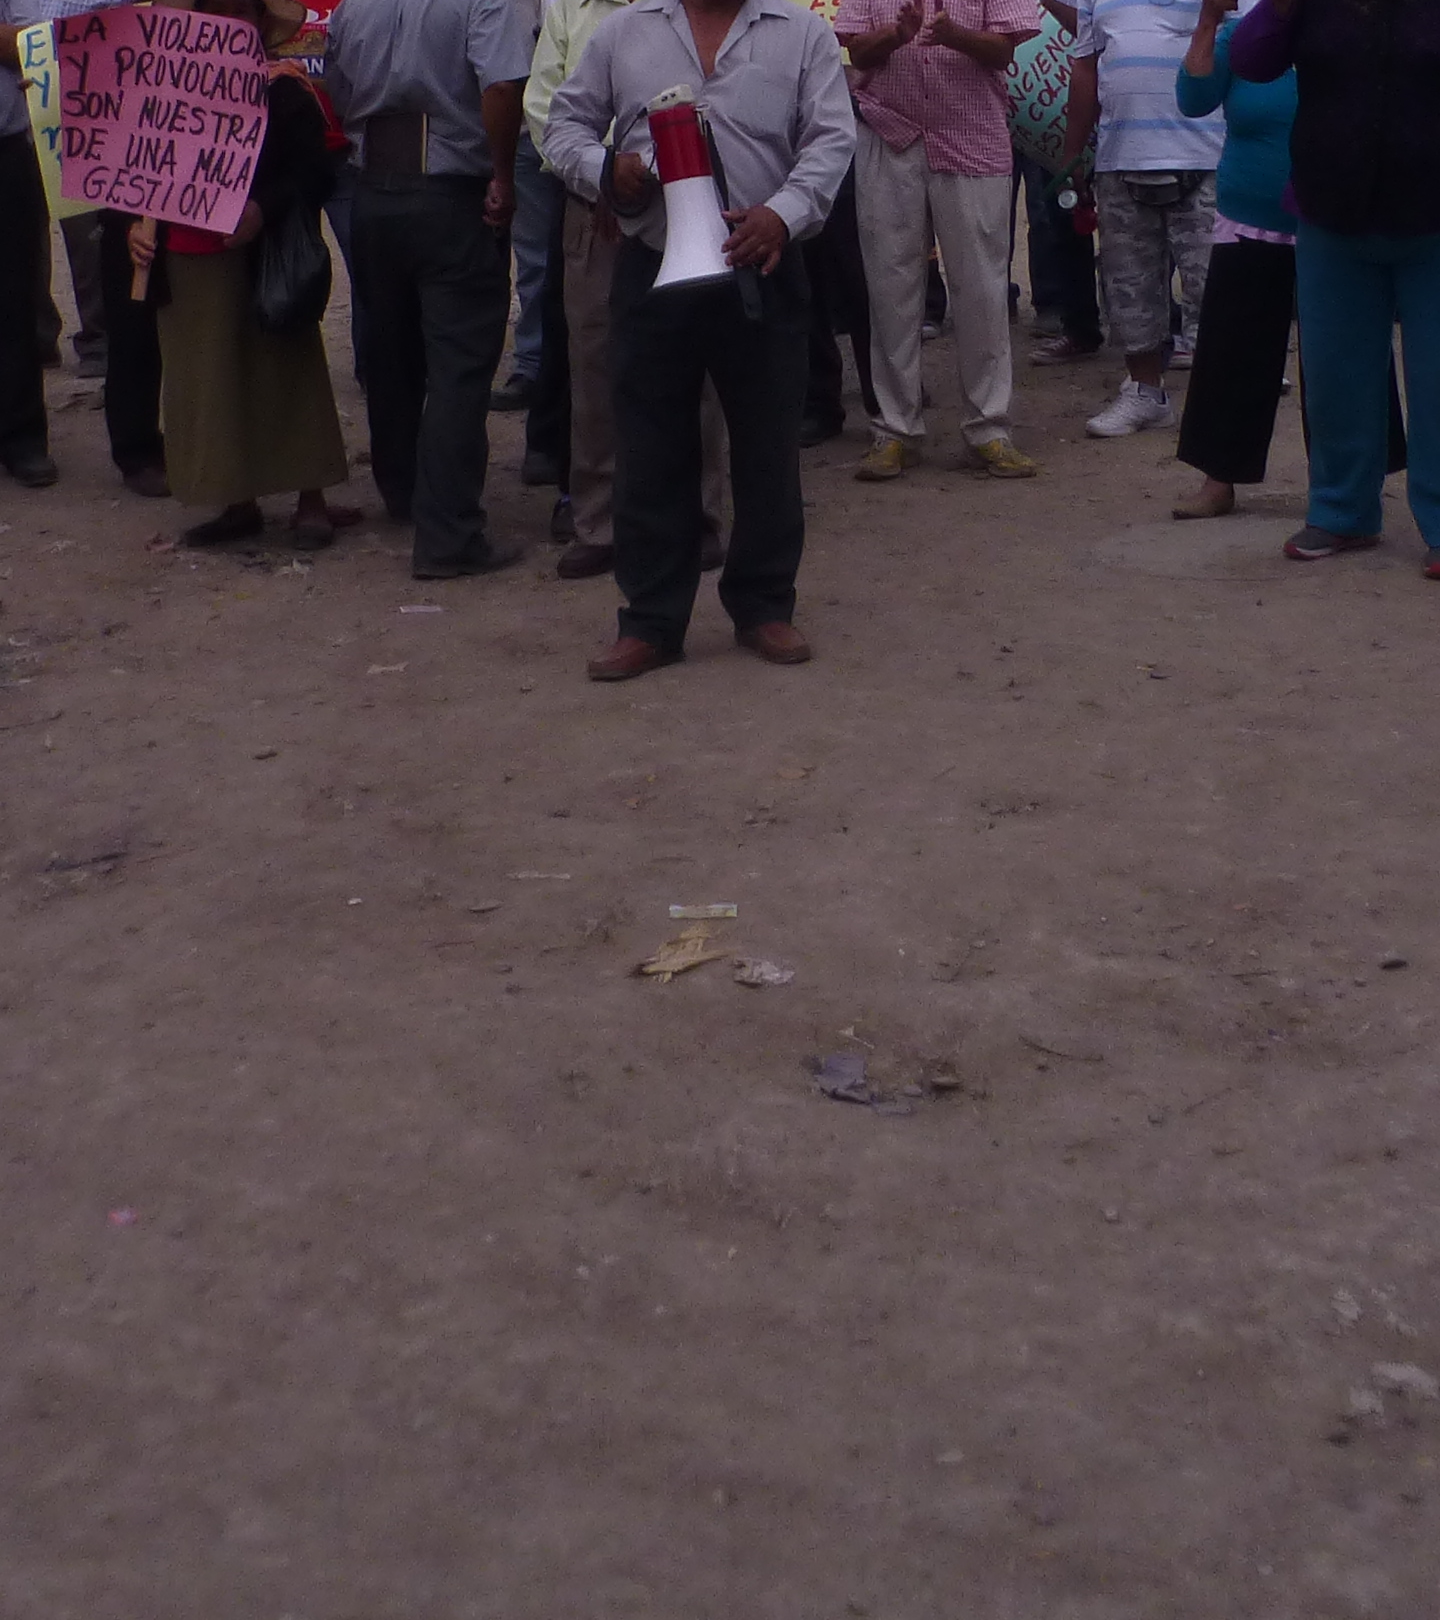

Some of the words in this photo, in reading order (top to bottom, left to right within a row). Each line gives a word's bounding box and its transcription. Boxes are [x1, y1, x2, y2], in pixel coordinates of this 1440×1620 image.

[60, 16, 108, 44] LA
[137, 14, 267, 66] VIOLENCIA
[67, 51, 89, 94] Y
[115, 46, 269, 108] PROVOCACION
[63, 90, 124, 121] SON
[138, 96, 261, 149] MUESTRA
[66, 127, 109, 160] DE
[125, 133, 177, 176] UNA
[192, 147, 253, 192] MALA
[83, 166, 220, 223] GESTION
